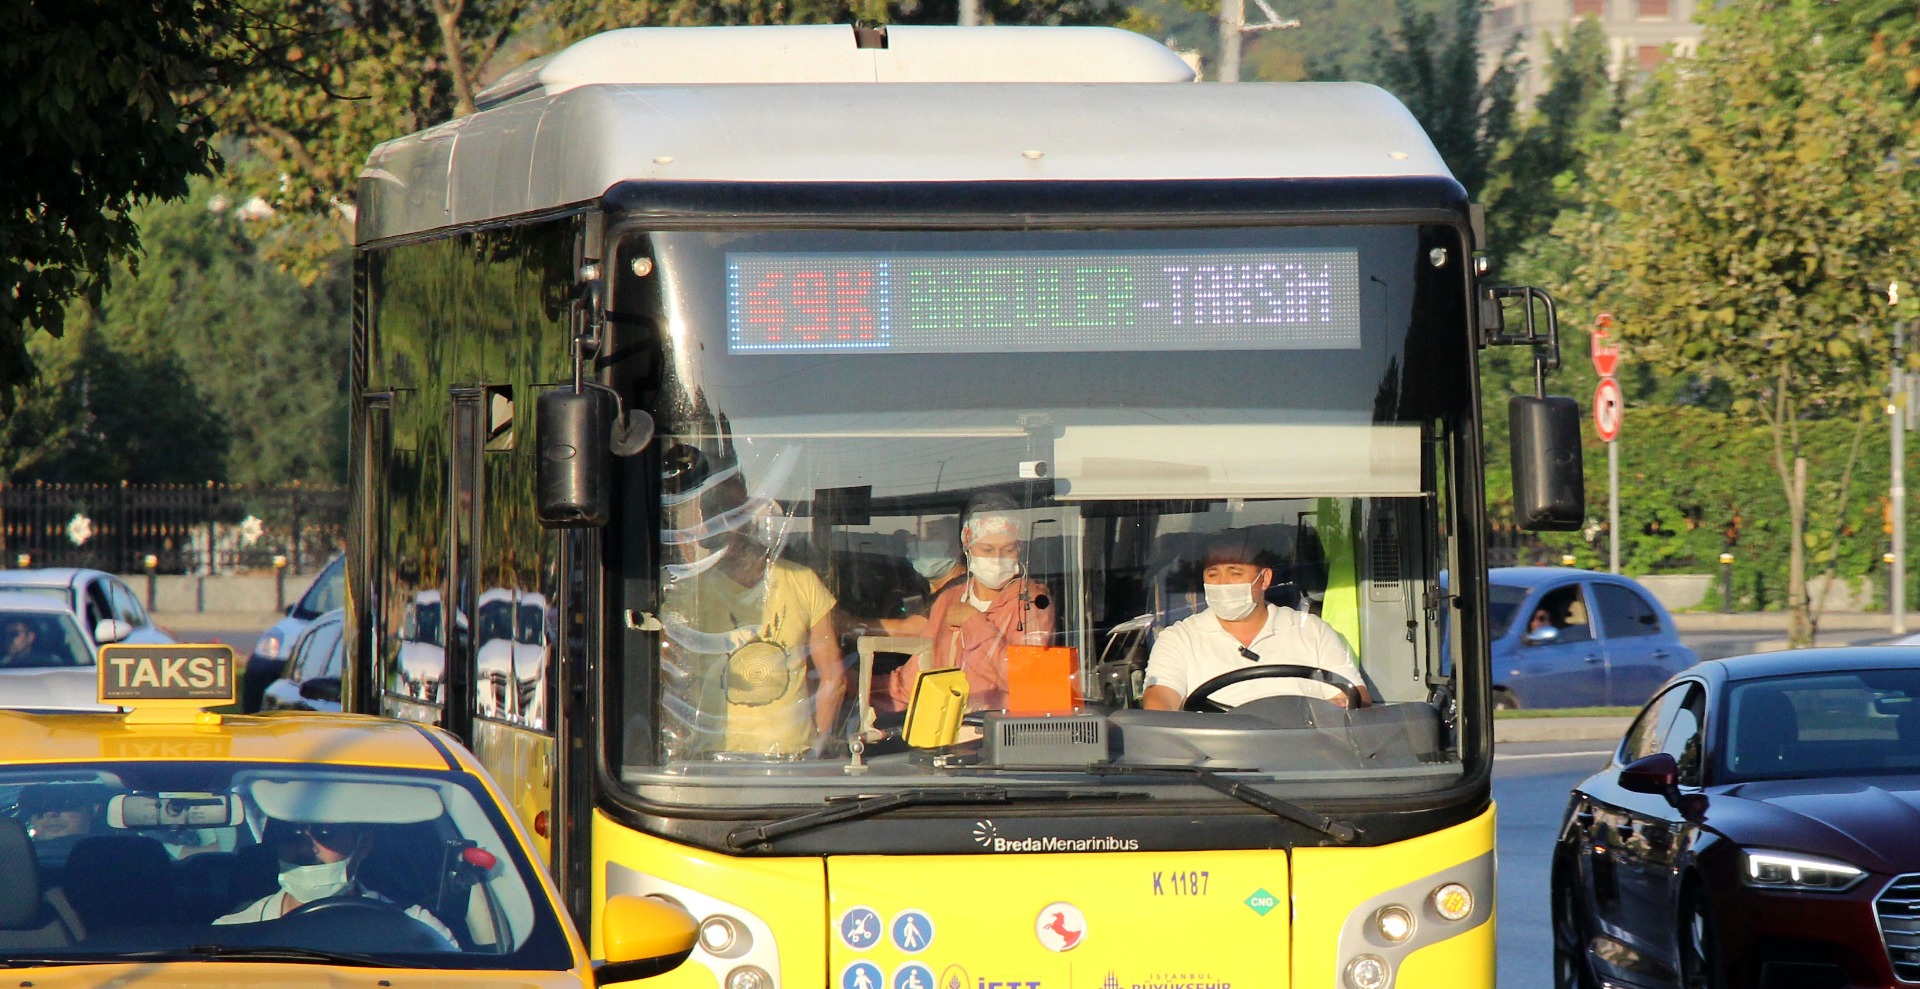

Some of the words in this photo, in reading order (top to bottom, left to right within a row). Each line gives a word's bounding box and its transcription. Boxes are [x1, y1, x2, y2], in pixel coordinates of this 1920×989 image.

[747, 271, 873, 341] 49K
[993, 836, 1139, 852] BredaMenarinibus
[1152, 871, 1164, 896] K
[1170, 871, 1209, 896] 1187
[1250, 896, 1274, 907] CNG
